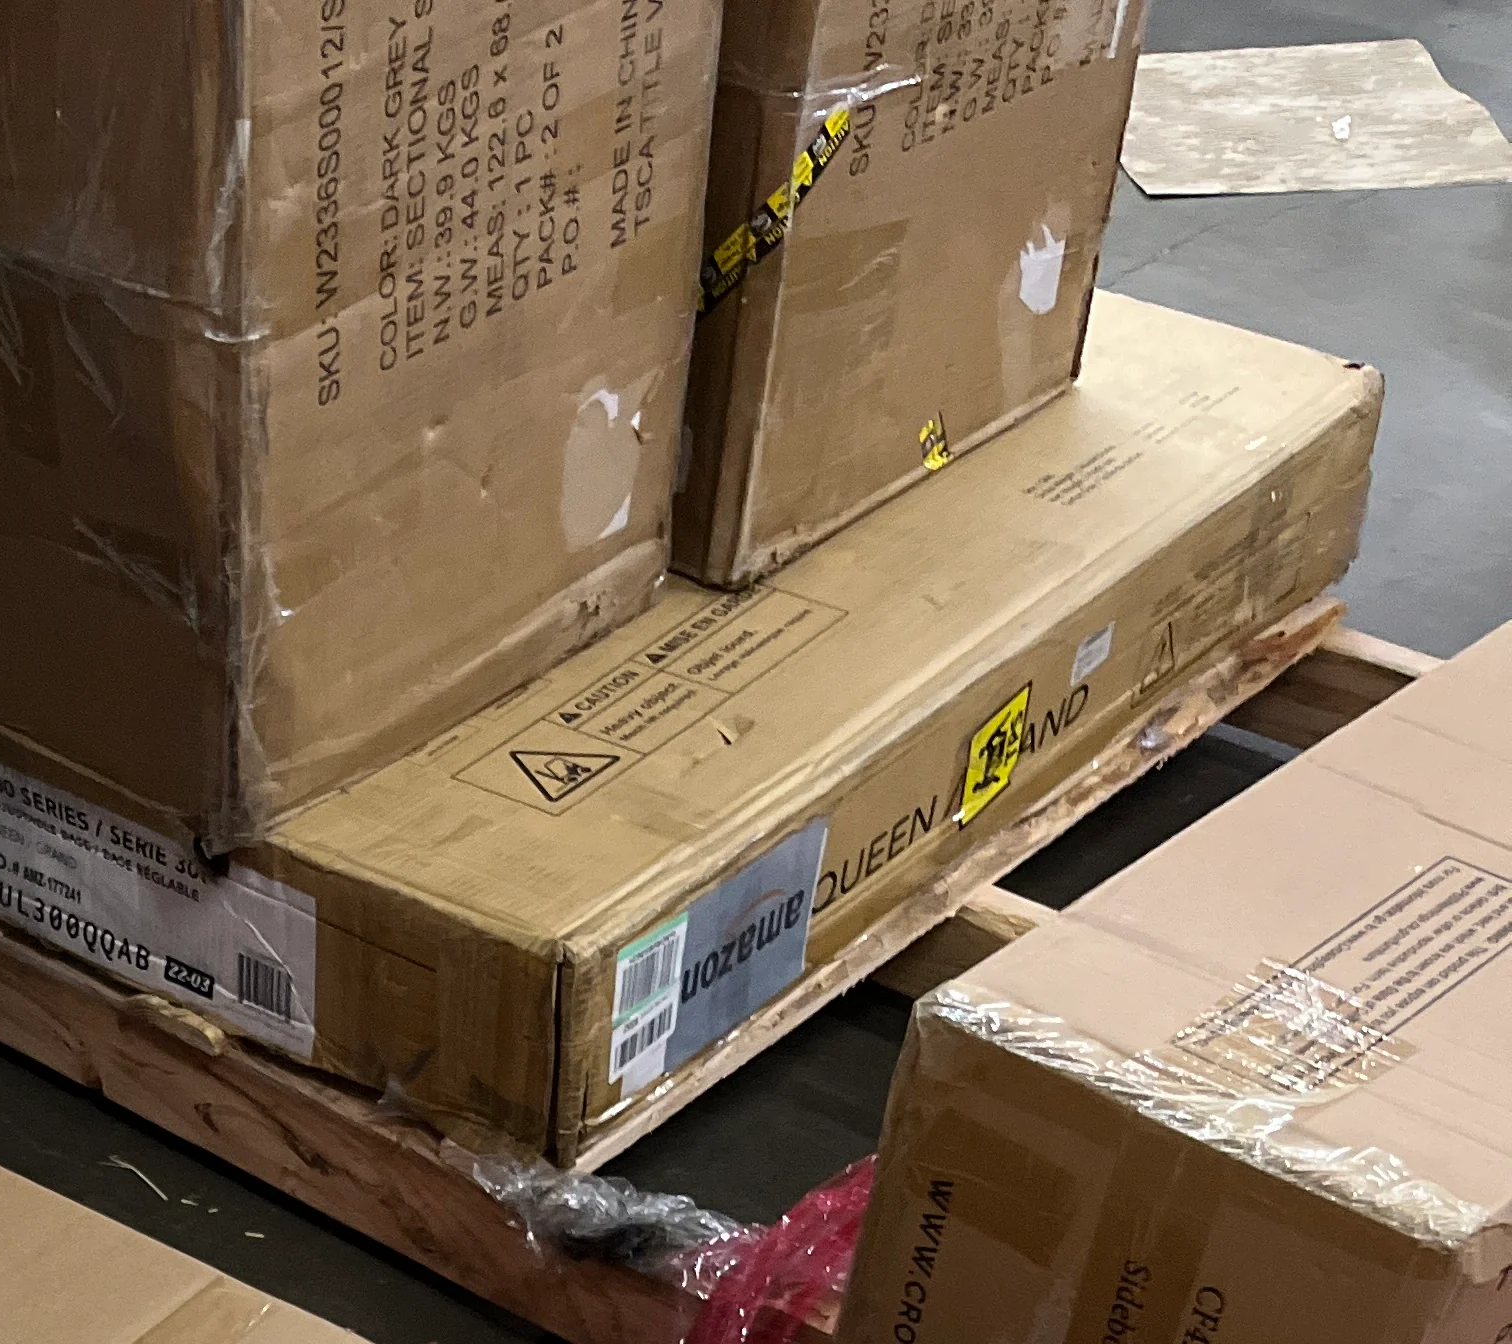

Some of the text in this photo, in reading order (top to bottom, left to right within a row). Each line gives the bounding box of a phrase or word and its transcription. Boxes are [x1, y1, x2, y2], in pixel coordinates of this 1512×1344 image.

[384, 16, 407, 118] GREY
[545, 24, 563, 48] 2
[436, 80, 456, 165] KGS
[461, 63, 480, 148] KGS
[542, 62, 561, 111] OF
[614, 95, 634, 134] IN
[406, 25, 433, 251] SECTIONAL
[515, 109, 534, 165] PC
[610, 140, 631, 249] MADE
[486, 199, 506, 318] MEAS:
[405, 257, 425, 361] ITEM:
[576, 669, 640, 713] CAUTION
[19, 786, 90, 832] SERIES
[110, 829, 168, 867] SERIE
[811, 795, 939, 915] QUEEN
[1020, 684, 1090, 754] AND
[681, 889, 806, 1003] amazon
